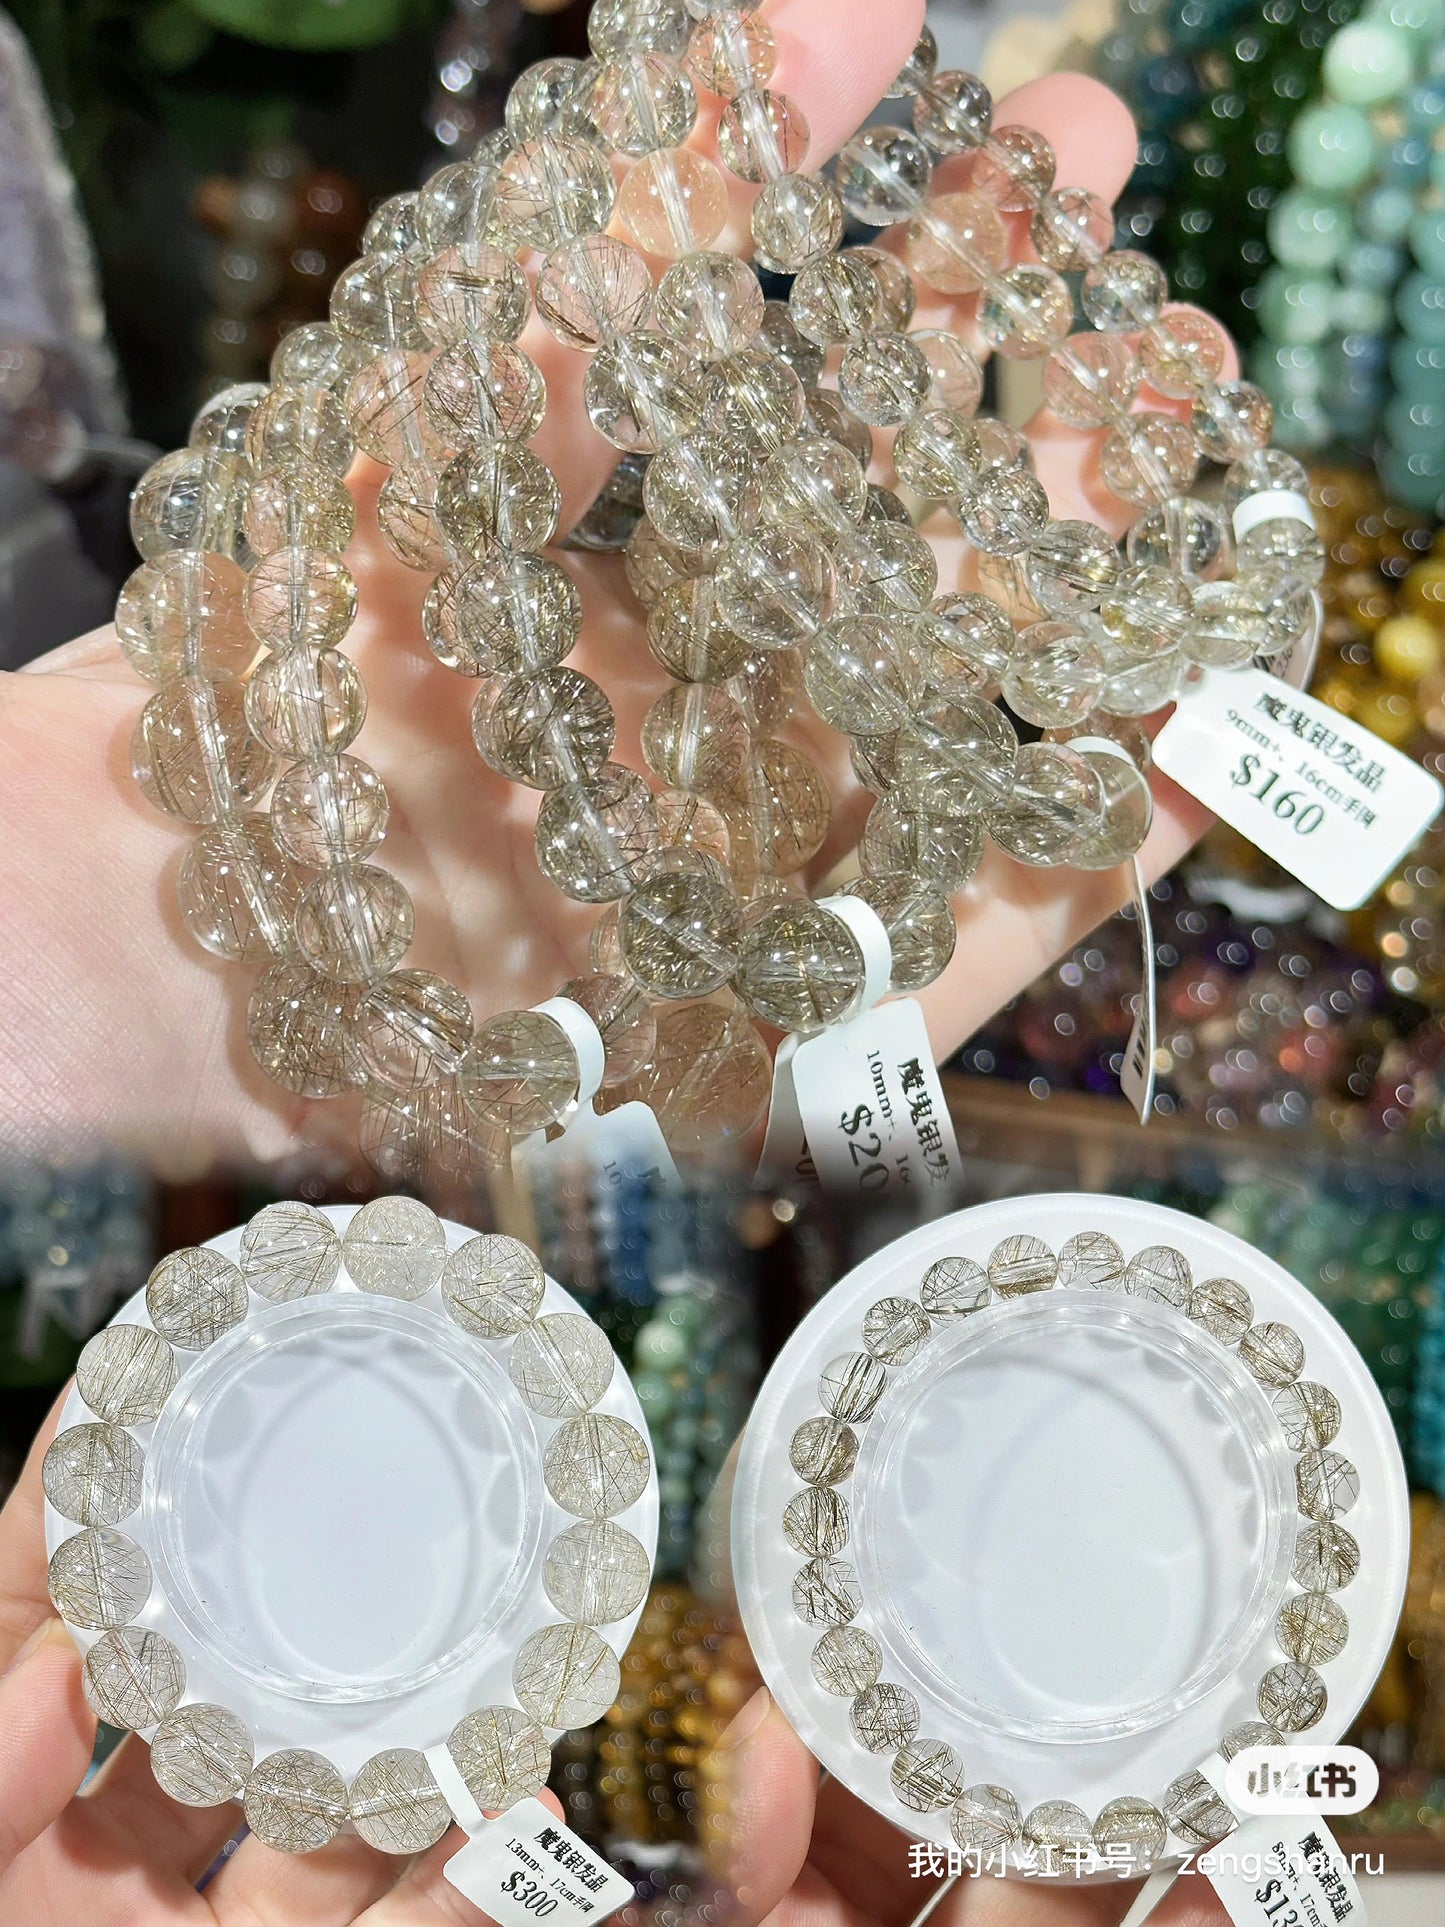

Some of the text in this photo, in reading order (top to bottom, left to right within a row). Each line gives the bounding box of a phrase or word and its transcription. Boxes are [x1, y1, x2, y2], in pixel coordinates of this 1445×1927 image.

[1229, 752, 1326, 836] $160
[500, 1870, 560, 1918] $300
[1254, 1878, 1305, 1927] $13
